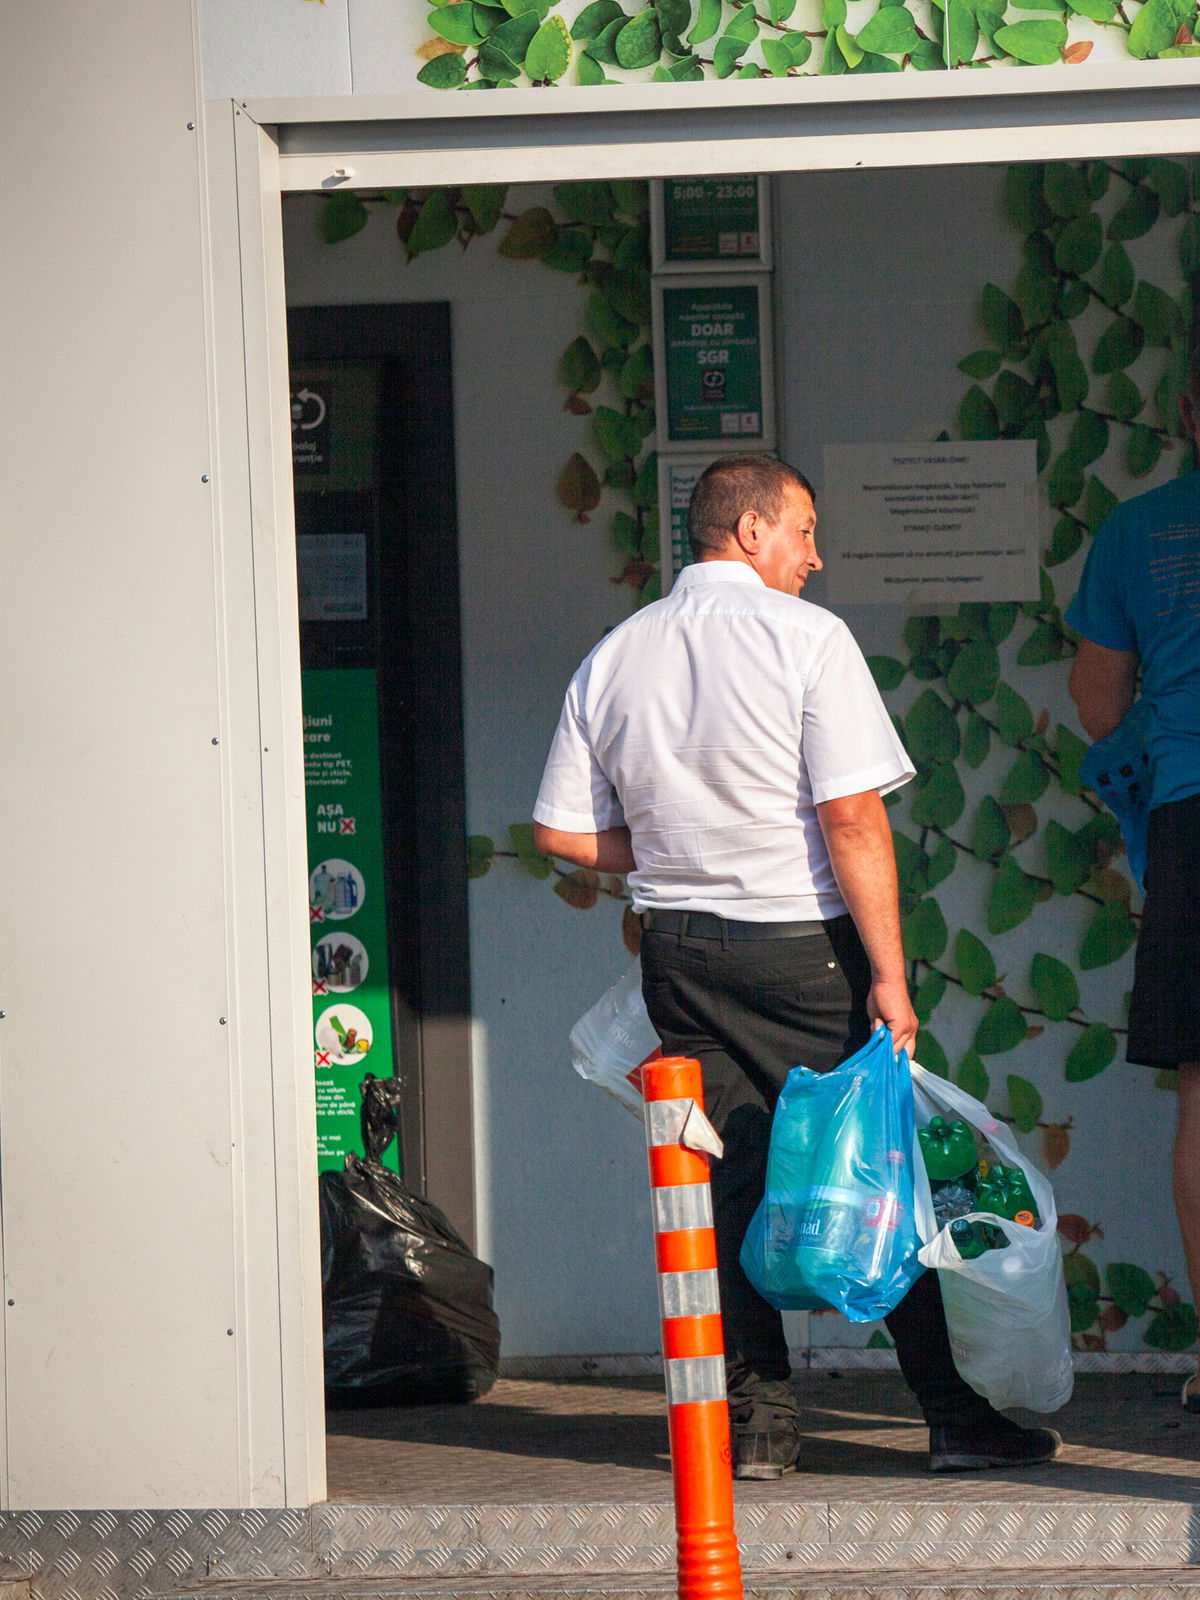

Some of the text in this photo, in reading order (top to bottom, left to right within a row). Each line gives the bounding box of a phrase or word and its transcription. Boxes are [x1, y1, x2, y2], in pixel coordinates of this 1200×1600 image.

[691, 323, 735, 337] DOAR
[697, 349, 729, 364] SGR
[316, 804, 344, 819] AȘA
[317, 821, 337, 833] NU
